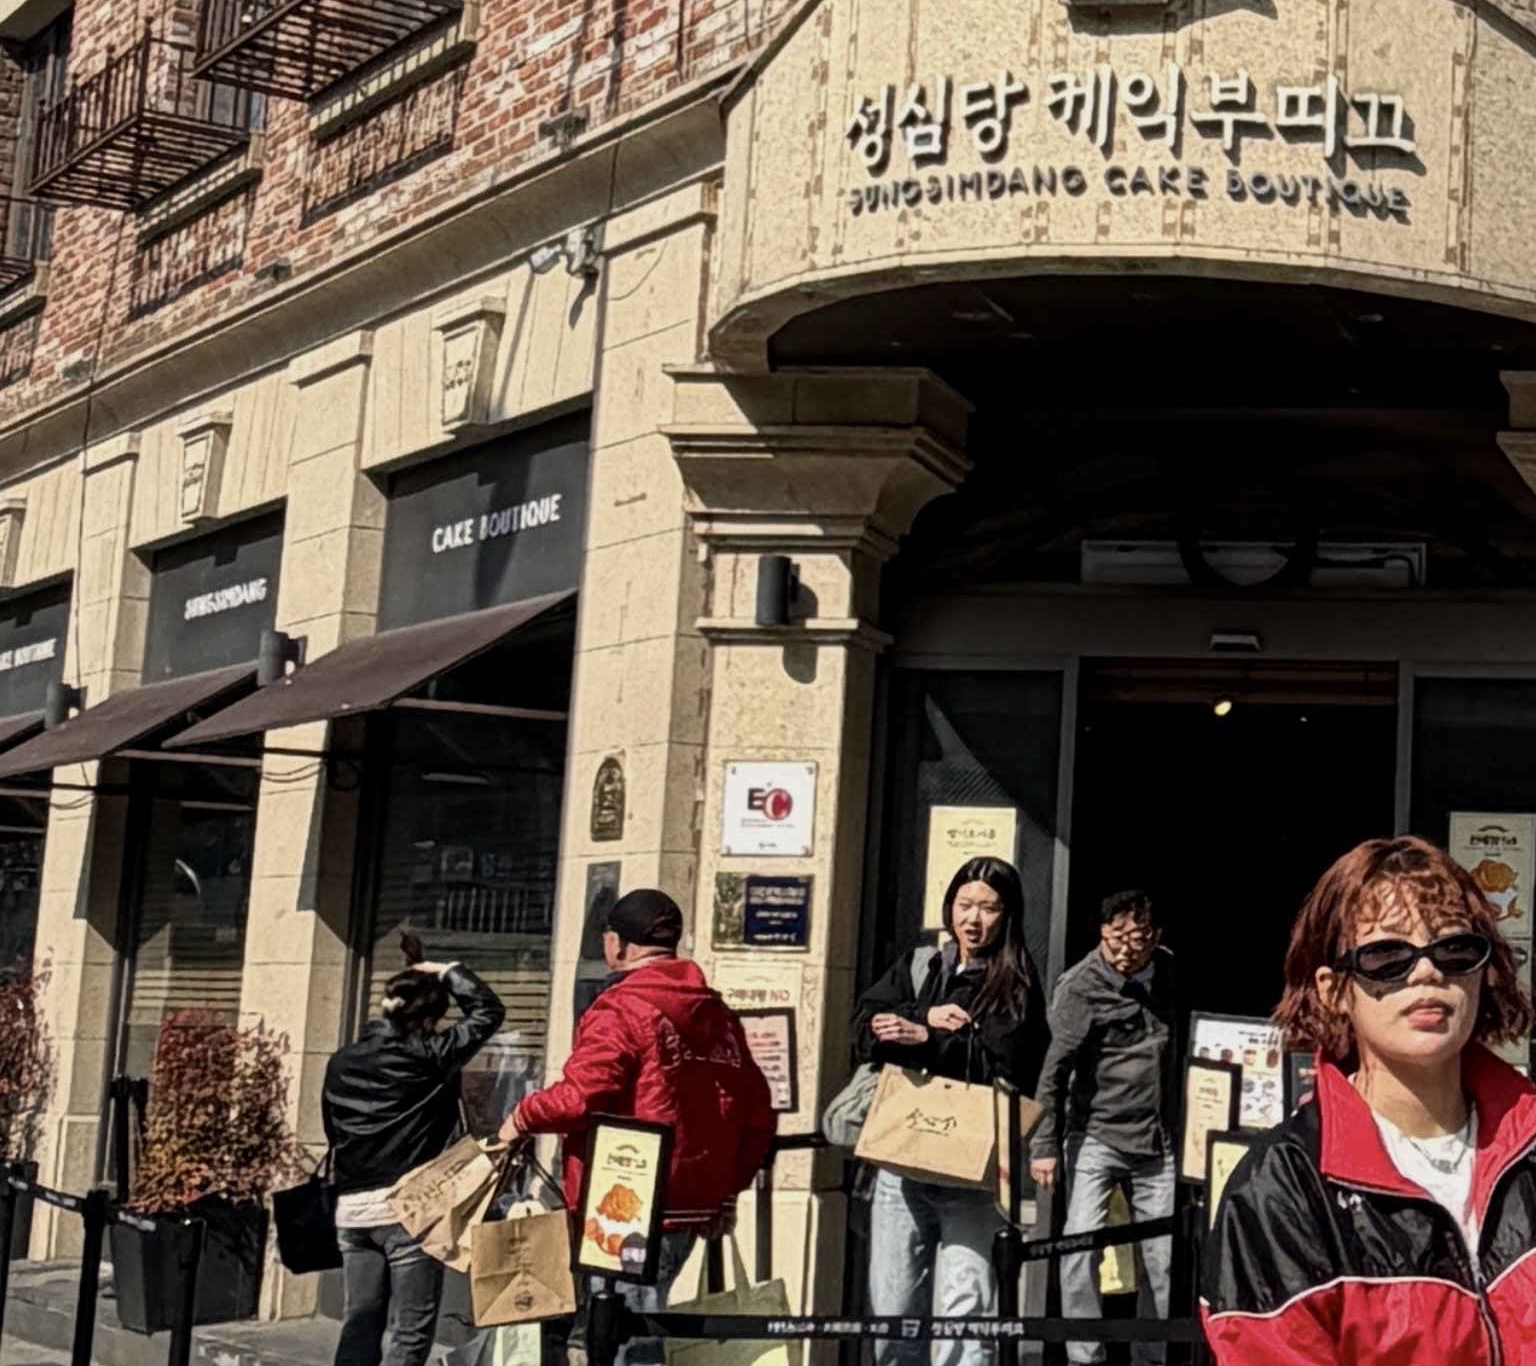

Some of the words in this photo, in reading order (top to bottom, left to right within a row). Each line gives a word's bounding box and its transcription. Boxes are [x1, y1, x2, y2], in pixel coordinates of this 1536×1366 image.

[847, 69, 1026, 168] 성심당
[1044, 63, 1416, 160] 케익부띠끄
[848, 166, 1087, 217] SUNGSIMDANG
[1104, 166, 1208, 199] CAKE
[1226, 170, 1412, 217] BOUTIQUE
[432, 518, 474, 553] CAKE
[479, 494, 562, 540] BOUTIQUE
